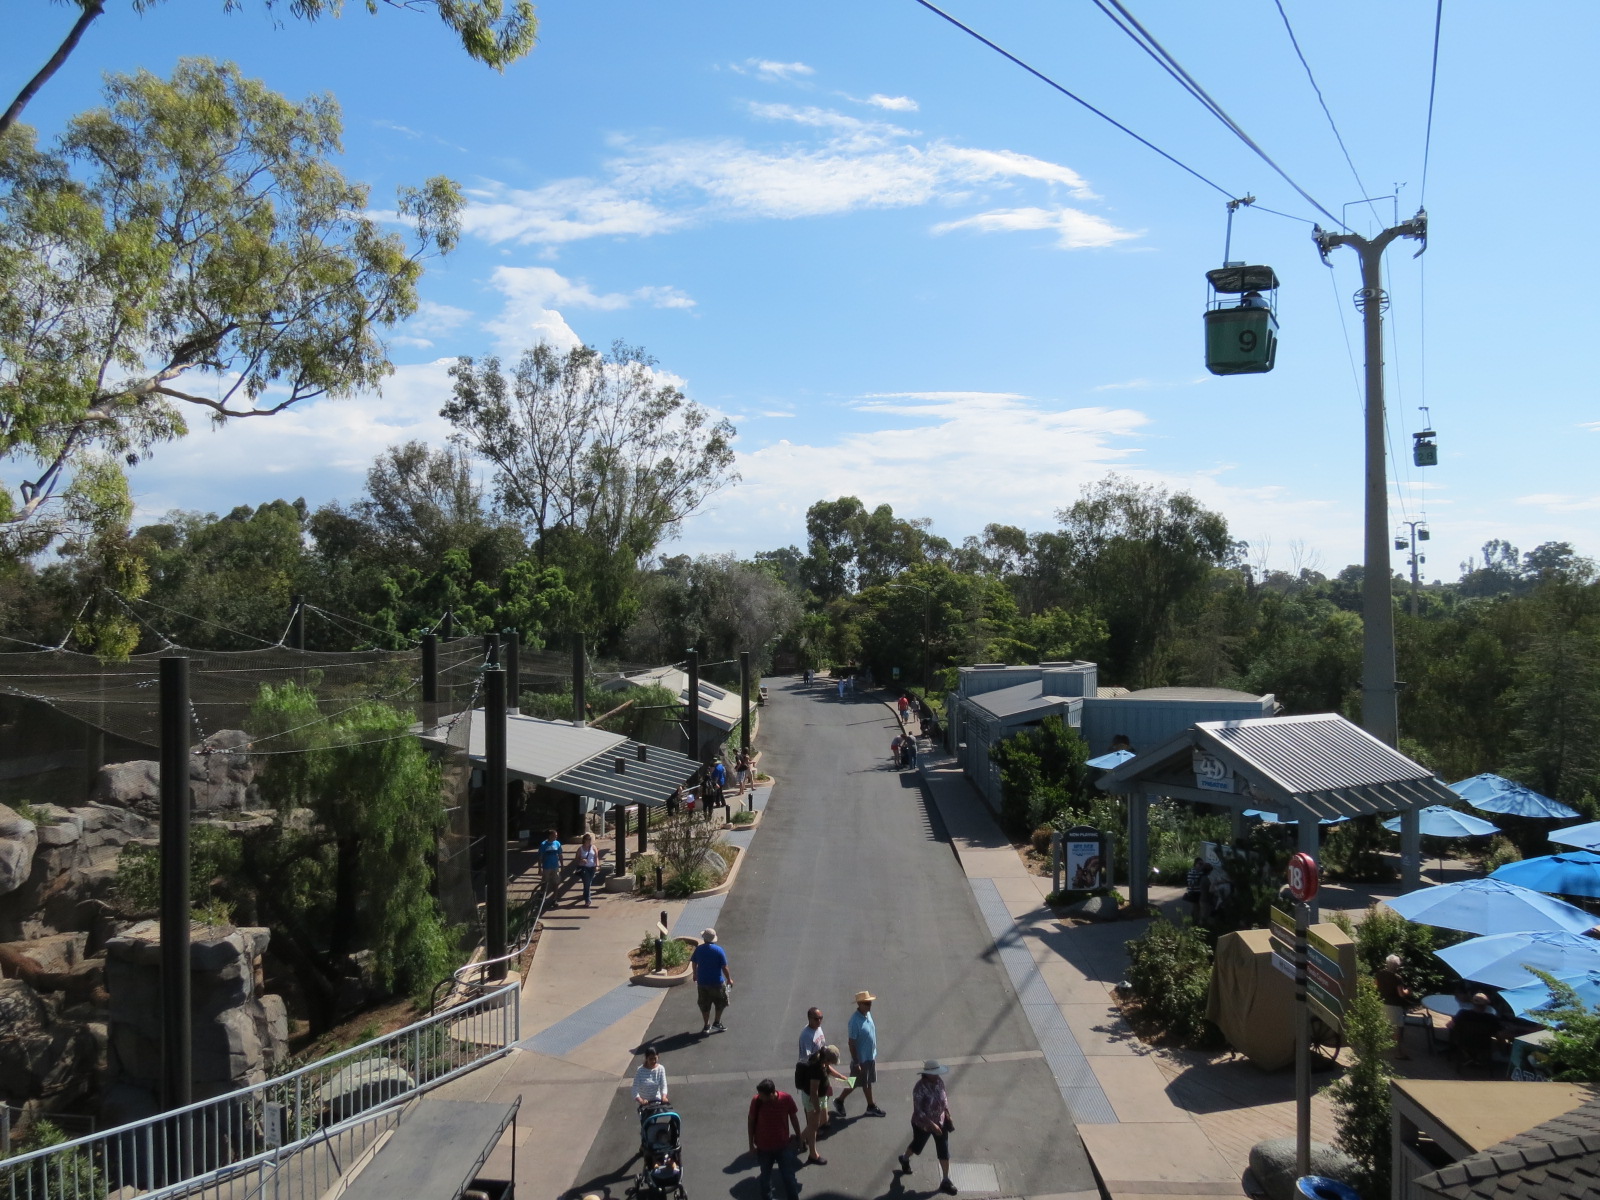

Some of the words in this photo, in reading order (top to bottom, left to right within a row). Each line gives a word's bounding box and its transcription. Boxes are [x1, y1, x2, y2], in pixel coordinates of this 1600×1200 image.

[1239, 330, 1257, 352] 9
[1200, 758, 1225, 780] 4D
[1289, 865, 1302, 890] 18
